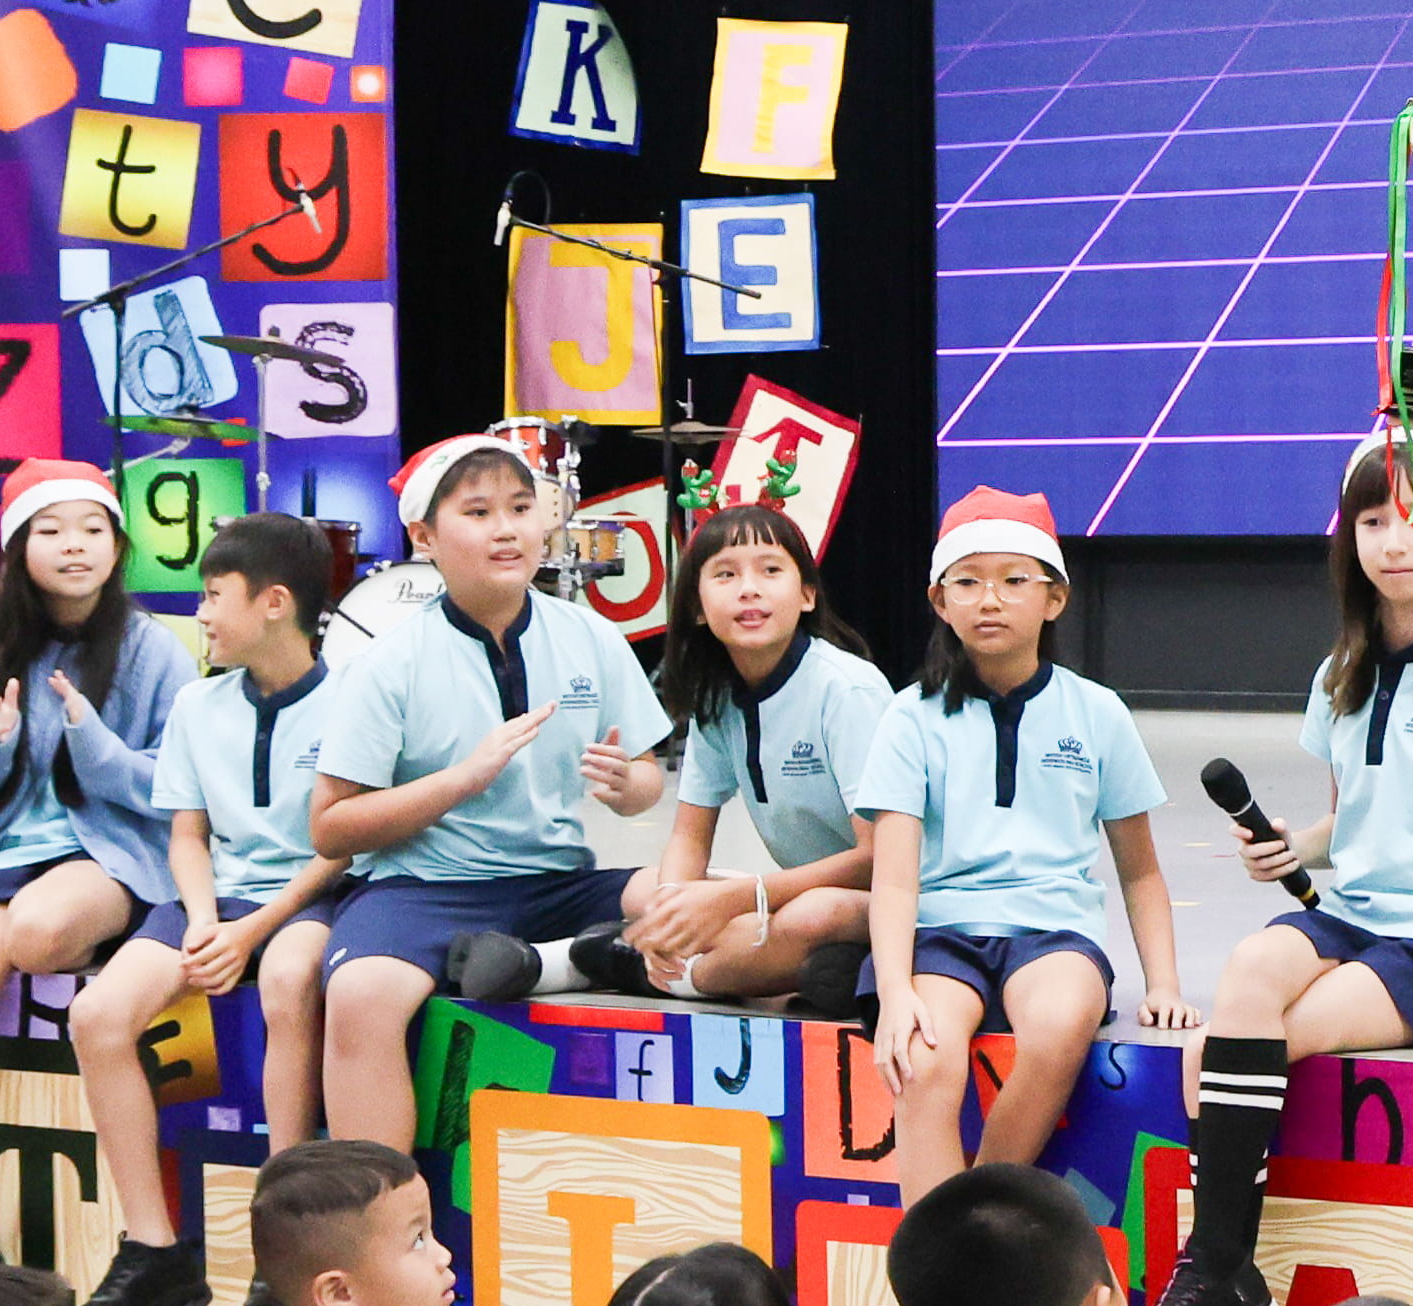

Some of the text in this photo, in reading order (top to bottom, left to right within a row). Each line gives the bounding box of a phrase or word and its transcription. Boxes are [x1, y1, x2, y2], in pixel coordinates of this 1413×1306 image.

[550, 20, 616, 132] K
[752, 43, 813, 154] F
[97, 124, 156, 235] t
[548, 241, 635, 393] J
[718, 217, 792, 331] E
[120, 290, 215, 417] d
[146, 470, 200, 570] g
[627, 1040, 654, 1101] f
[714, 1018, 752, 1095] J
